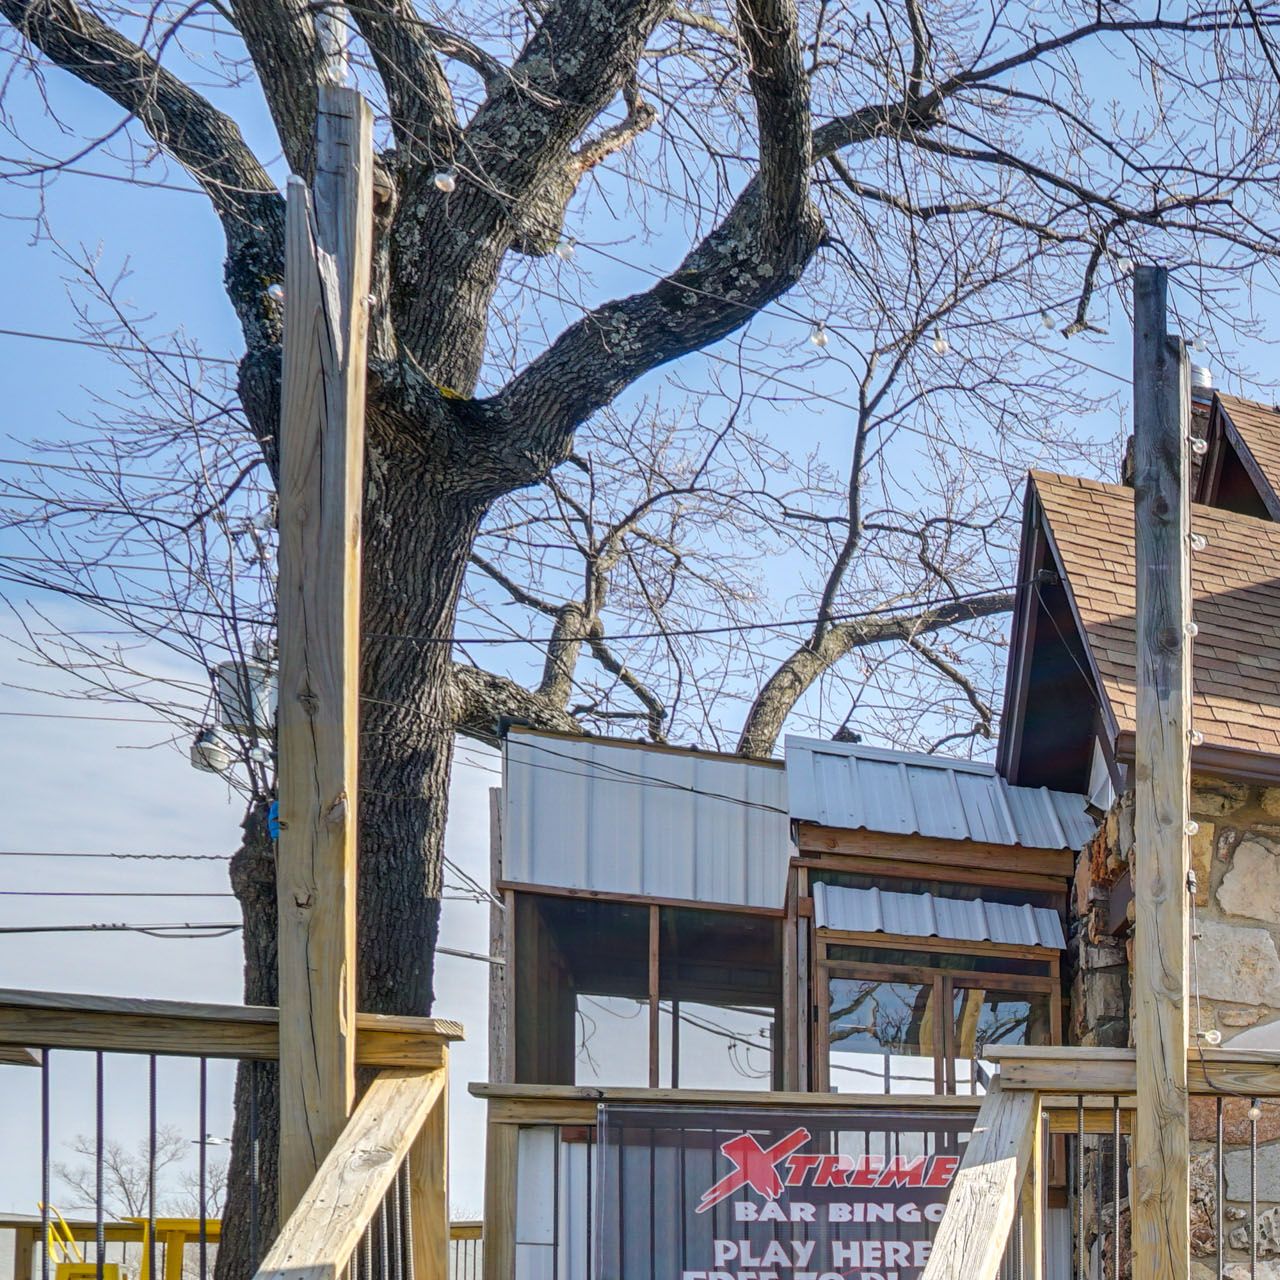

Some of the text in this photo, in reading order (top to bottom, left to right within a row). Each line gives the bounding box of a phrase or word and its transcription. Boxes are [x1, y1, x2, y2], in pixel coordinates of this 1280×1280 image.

[695, 1127, 961, 1213] XTREME
[734, 1202, 947, 1223] BAR BINGO
[713, 1240, 933, 1268] PLAY HERE
